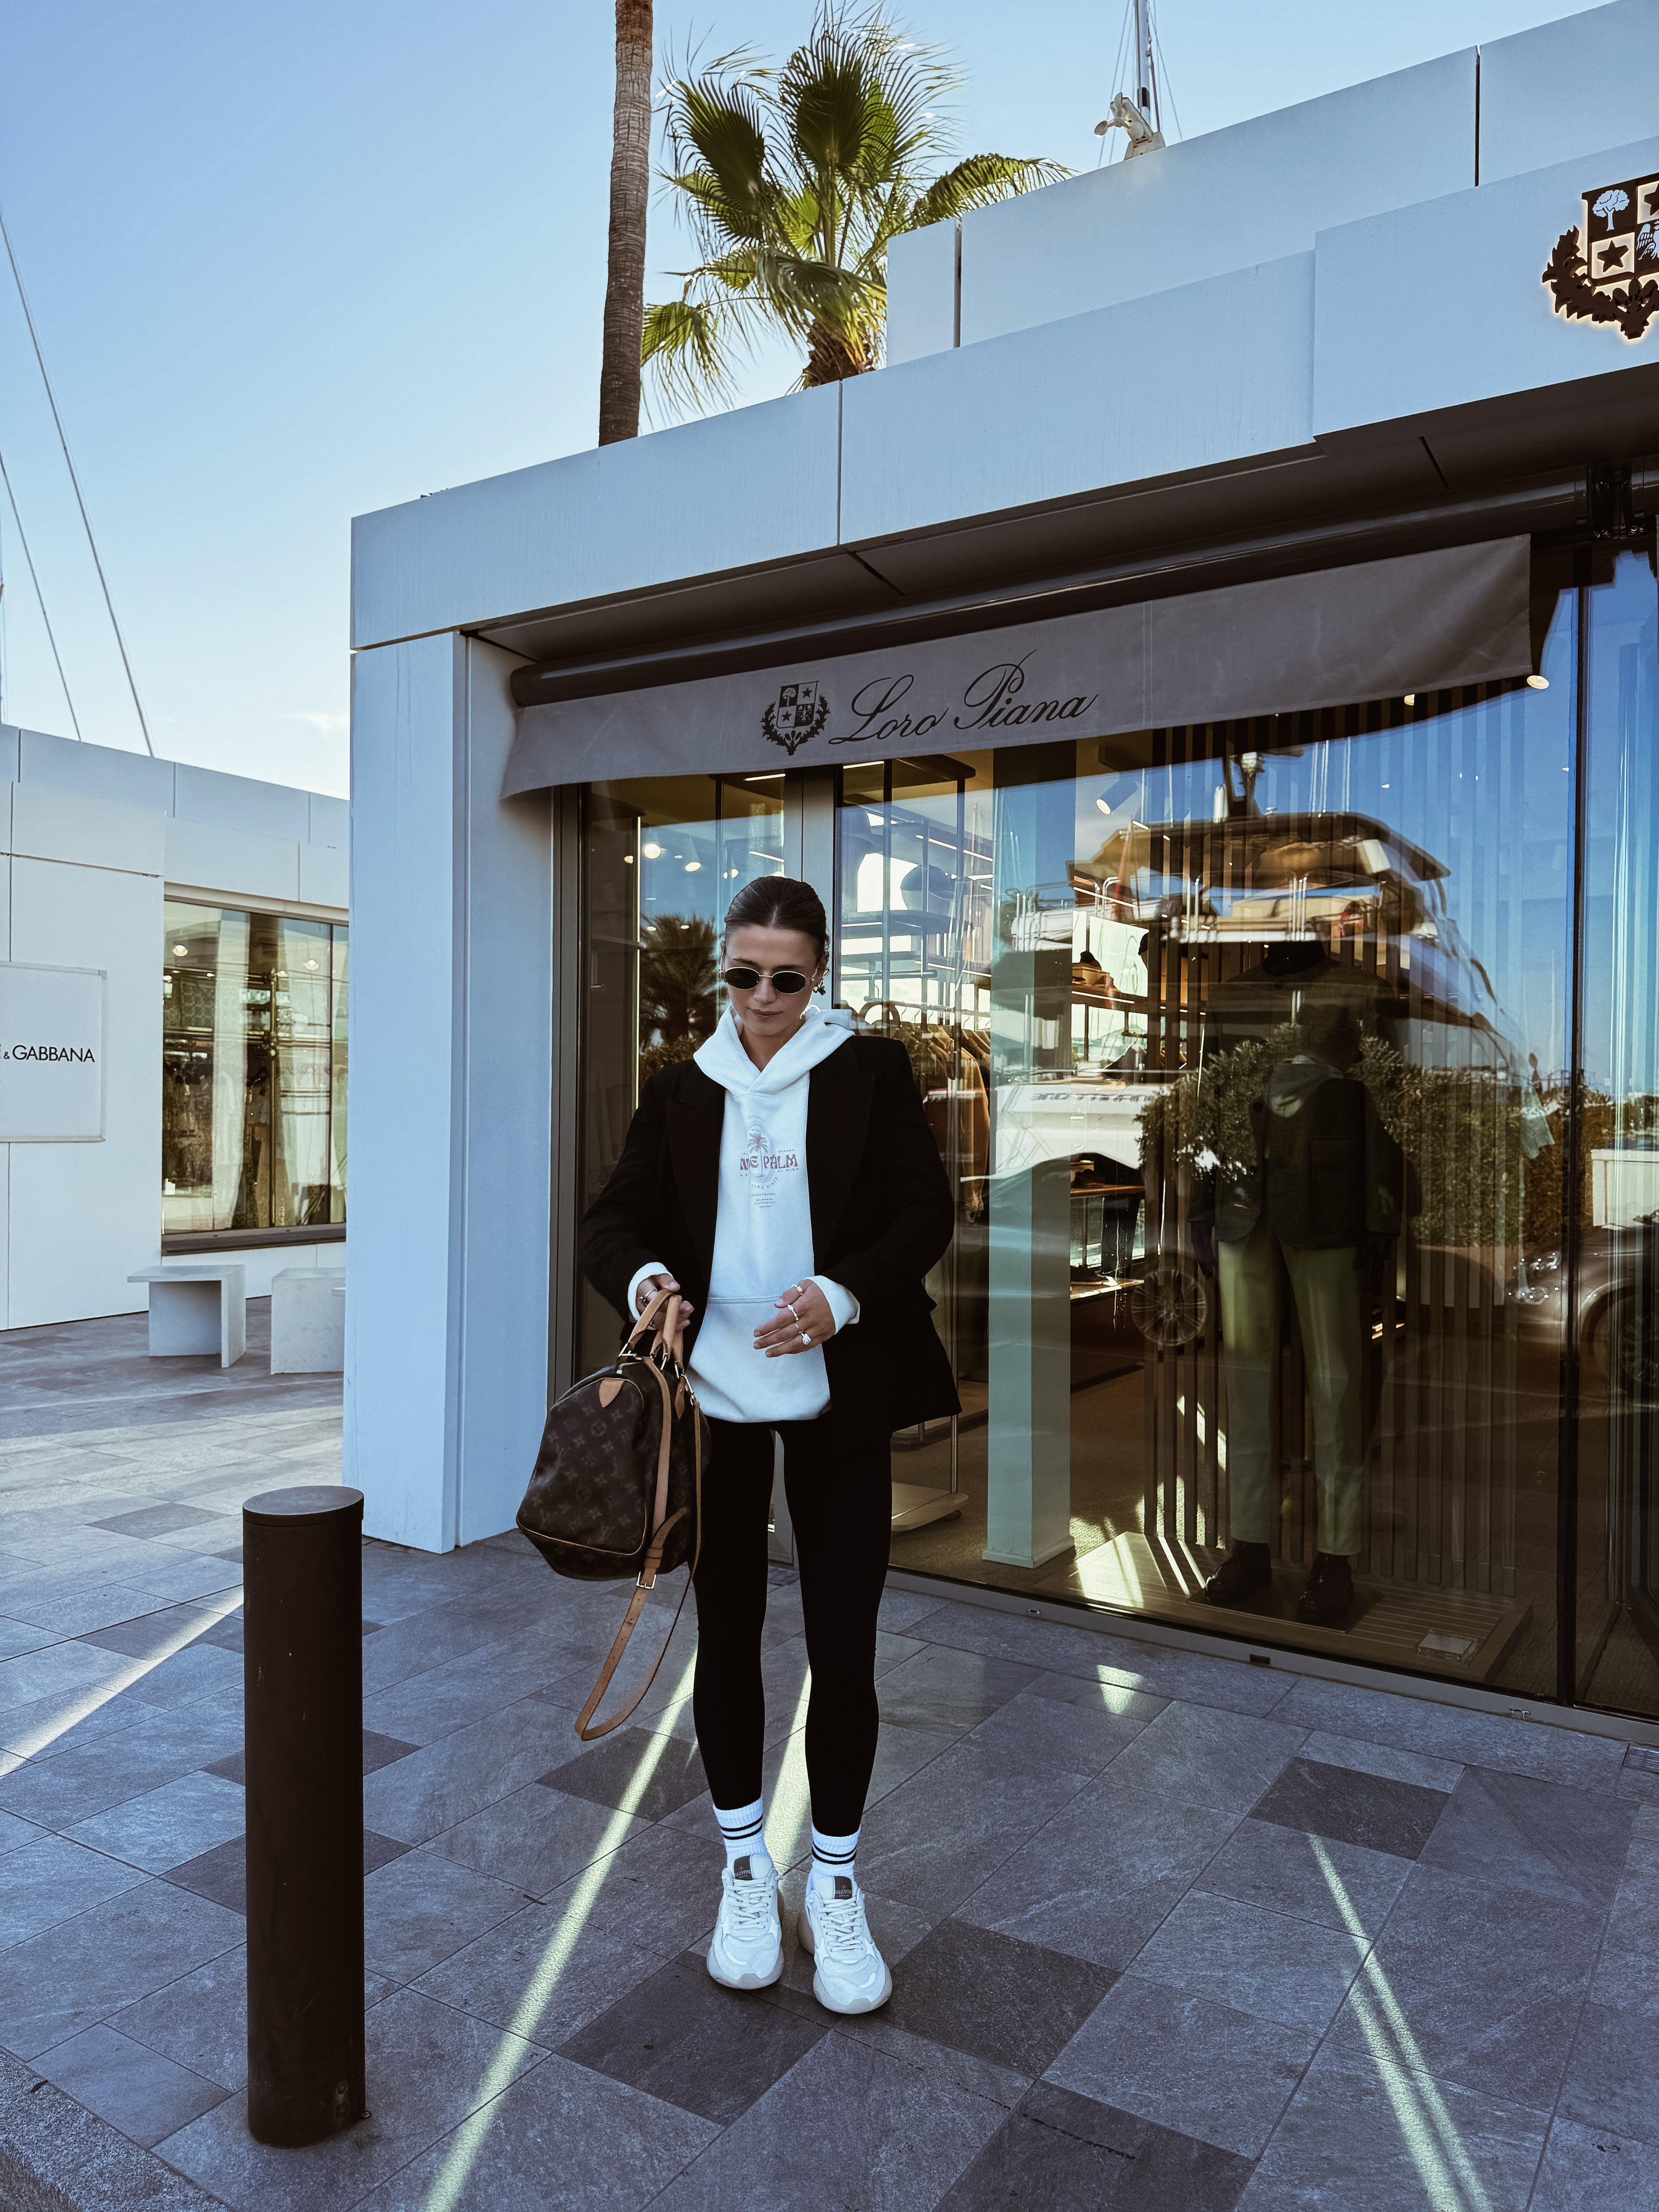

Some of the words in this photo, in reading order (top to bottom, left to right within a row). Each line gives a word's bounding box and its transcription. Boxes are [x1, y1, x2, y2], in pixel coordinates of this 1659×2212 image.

[828, 674, 949, 745] Loro
[953, 649, 1099, 730] Piana
[3, 1051, 10, 1059] &
[13, 1045, 95, 1063] GABBANA
